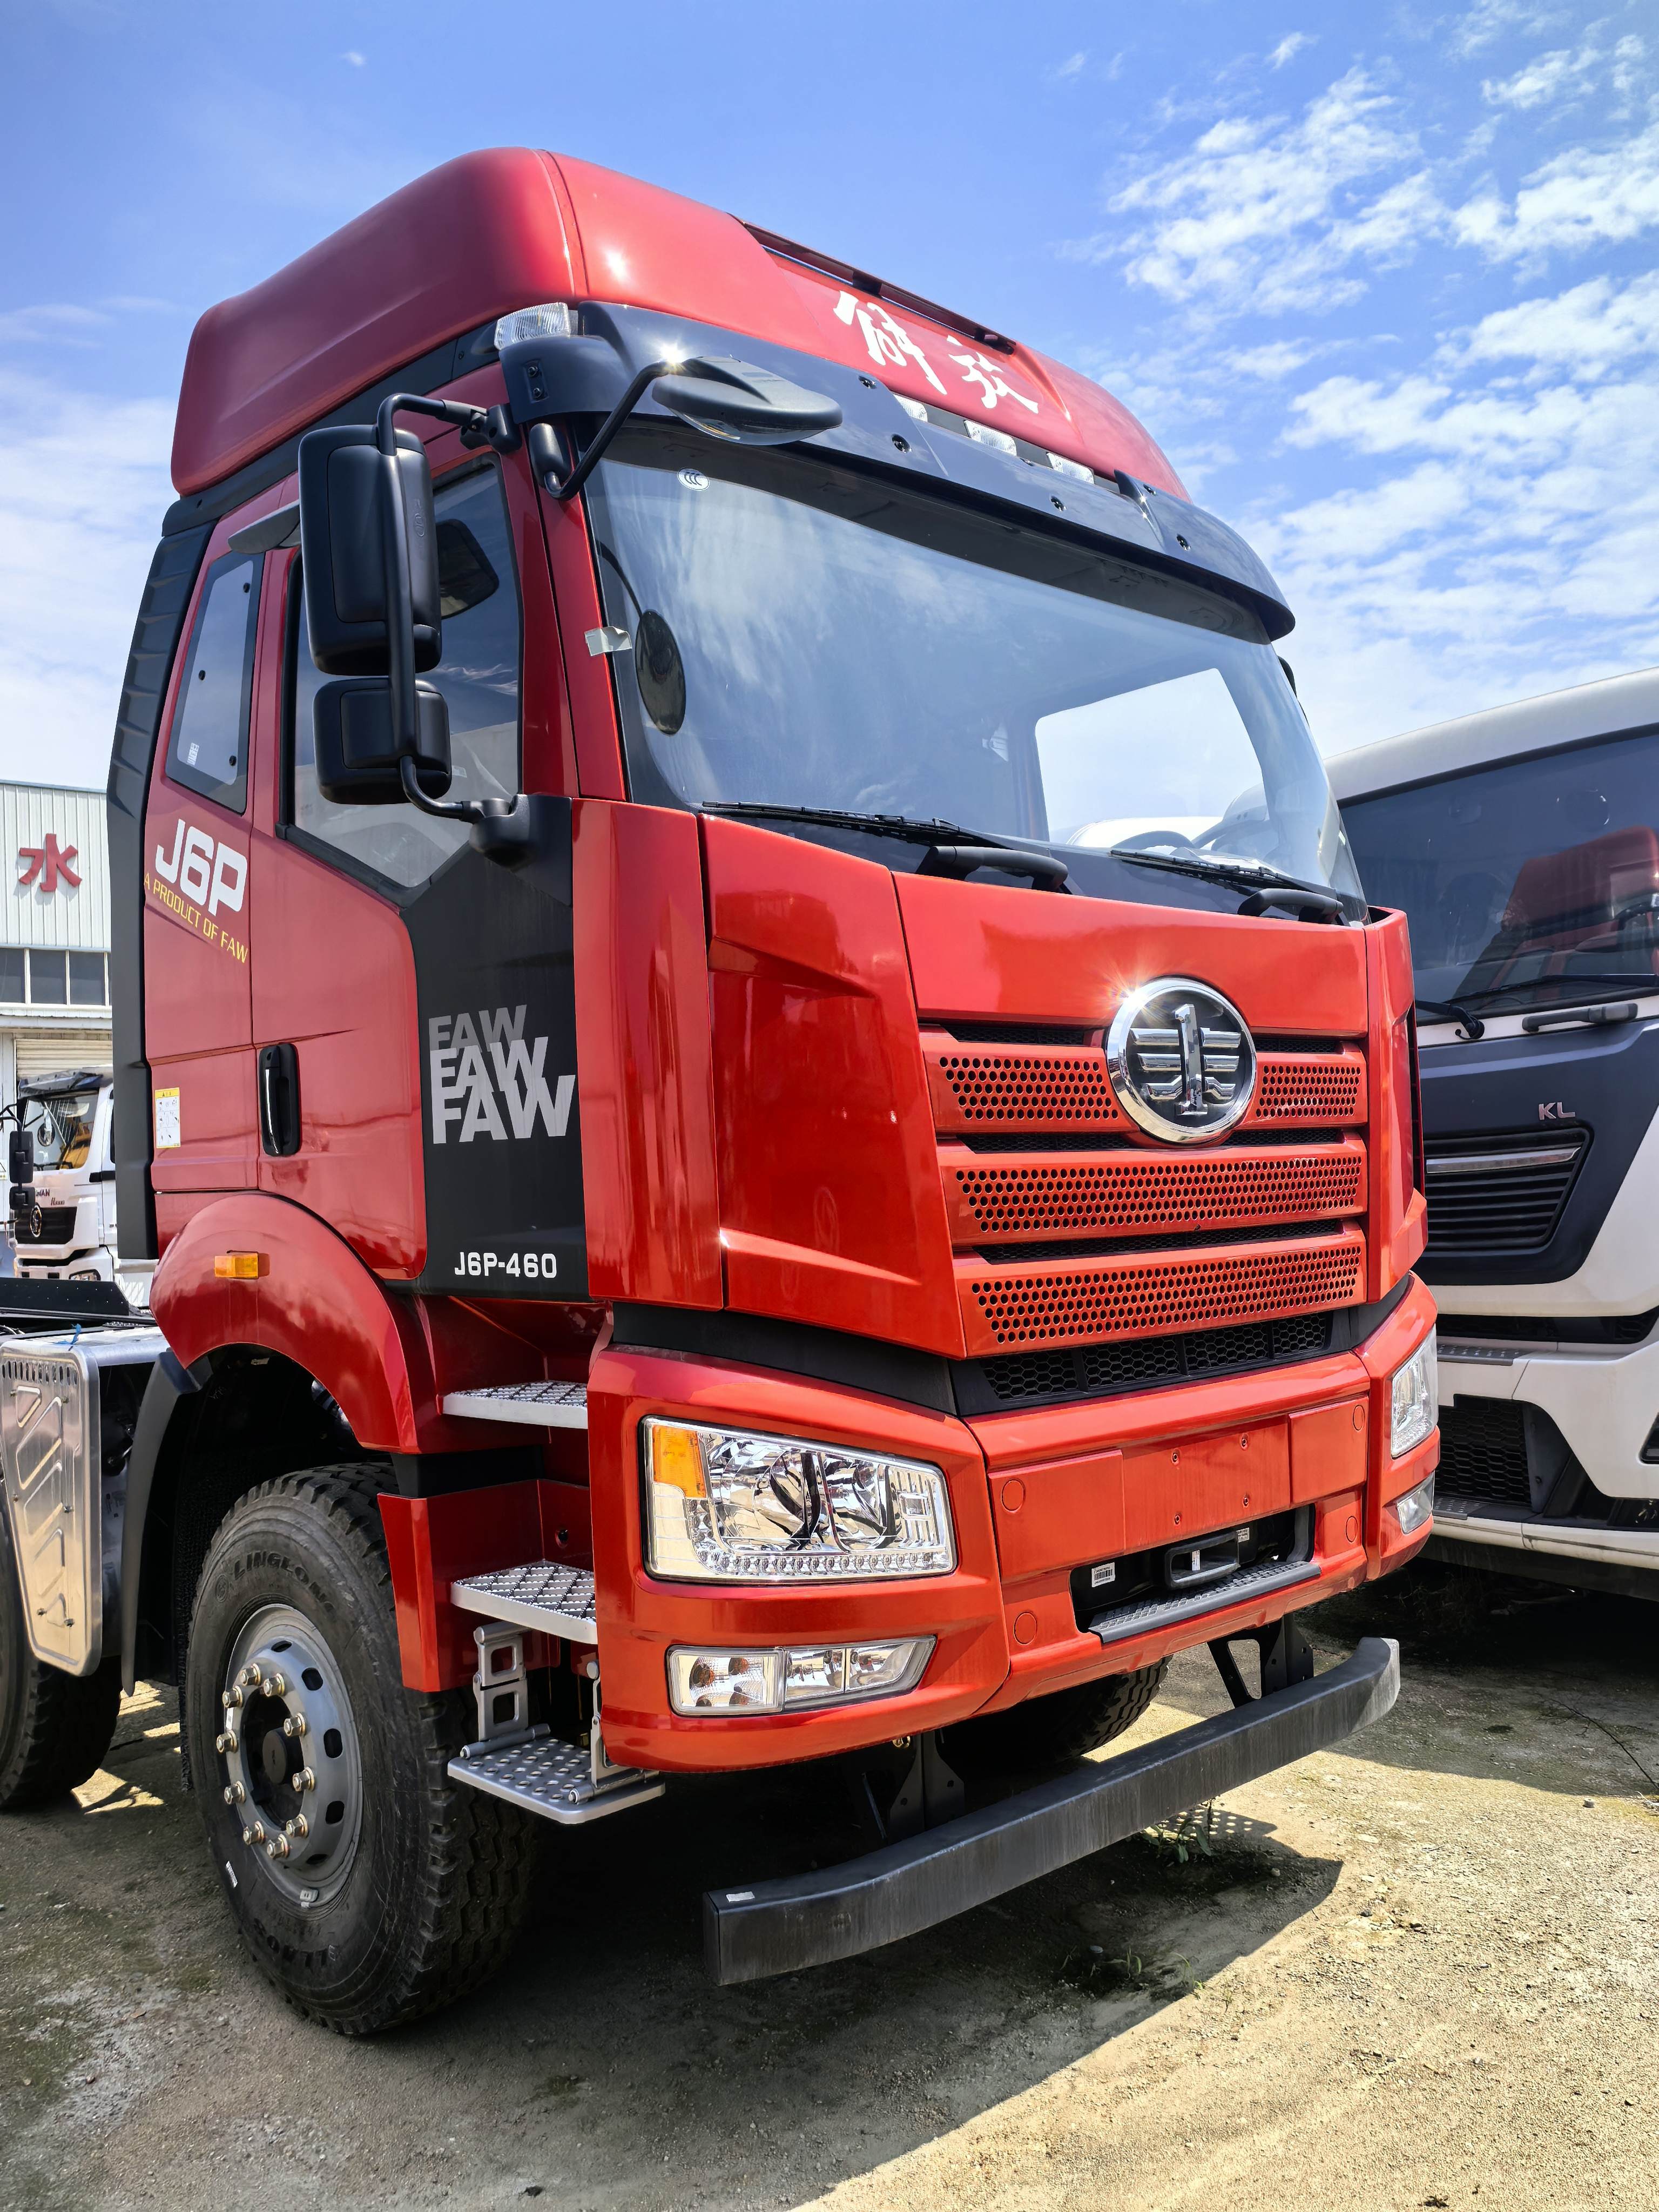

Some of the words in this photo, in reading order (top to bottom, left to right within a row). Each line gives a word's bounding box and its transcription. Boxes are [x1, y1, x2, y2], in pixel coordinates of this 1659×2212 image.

[18, 833, 83, 893] 水
[155, 818, 248, 916] J6P
[144, 872, 150, 890] A
[153, 879, 201, 929] PRODUCT
[203, 918, 219, 940] OF
[220, 930, 248, 963] FAW
[429, 1004, 527, 1054] FAW
[430, 1036, 549, 1097] FAW
[432, 1074, 576, 1144] FAW
[1538, 1102, 1576, 1121] KL
[454, 1251, 557, 1278] J6P-460
[234, 1550, 338, 1622] LINGLONG
